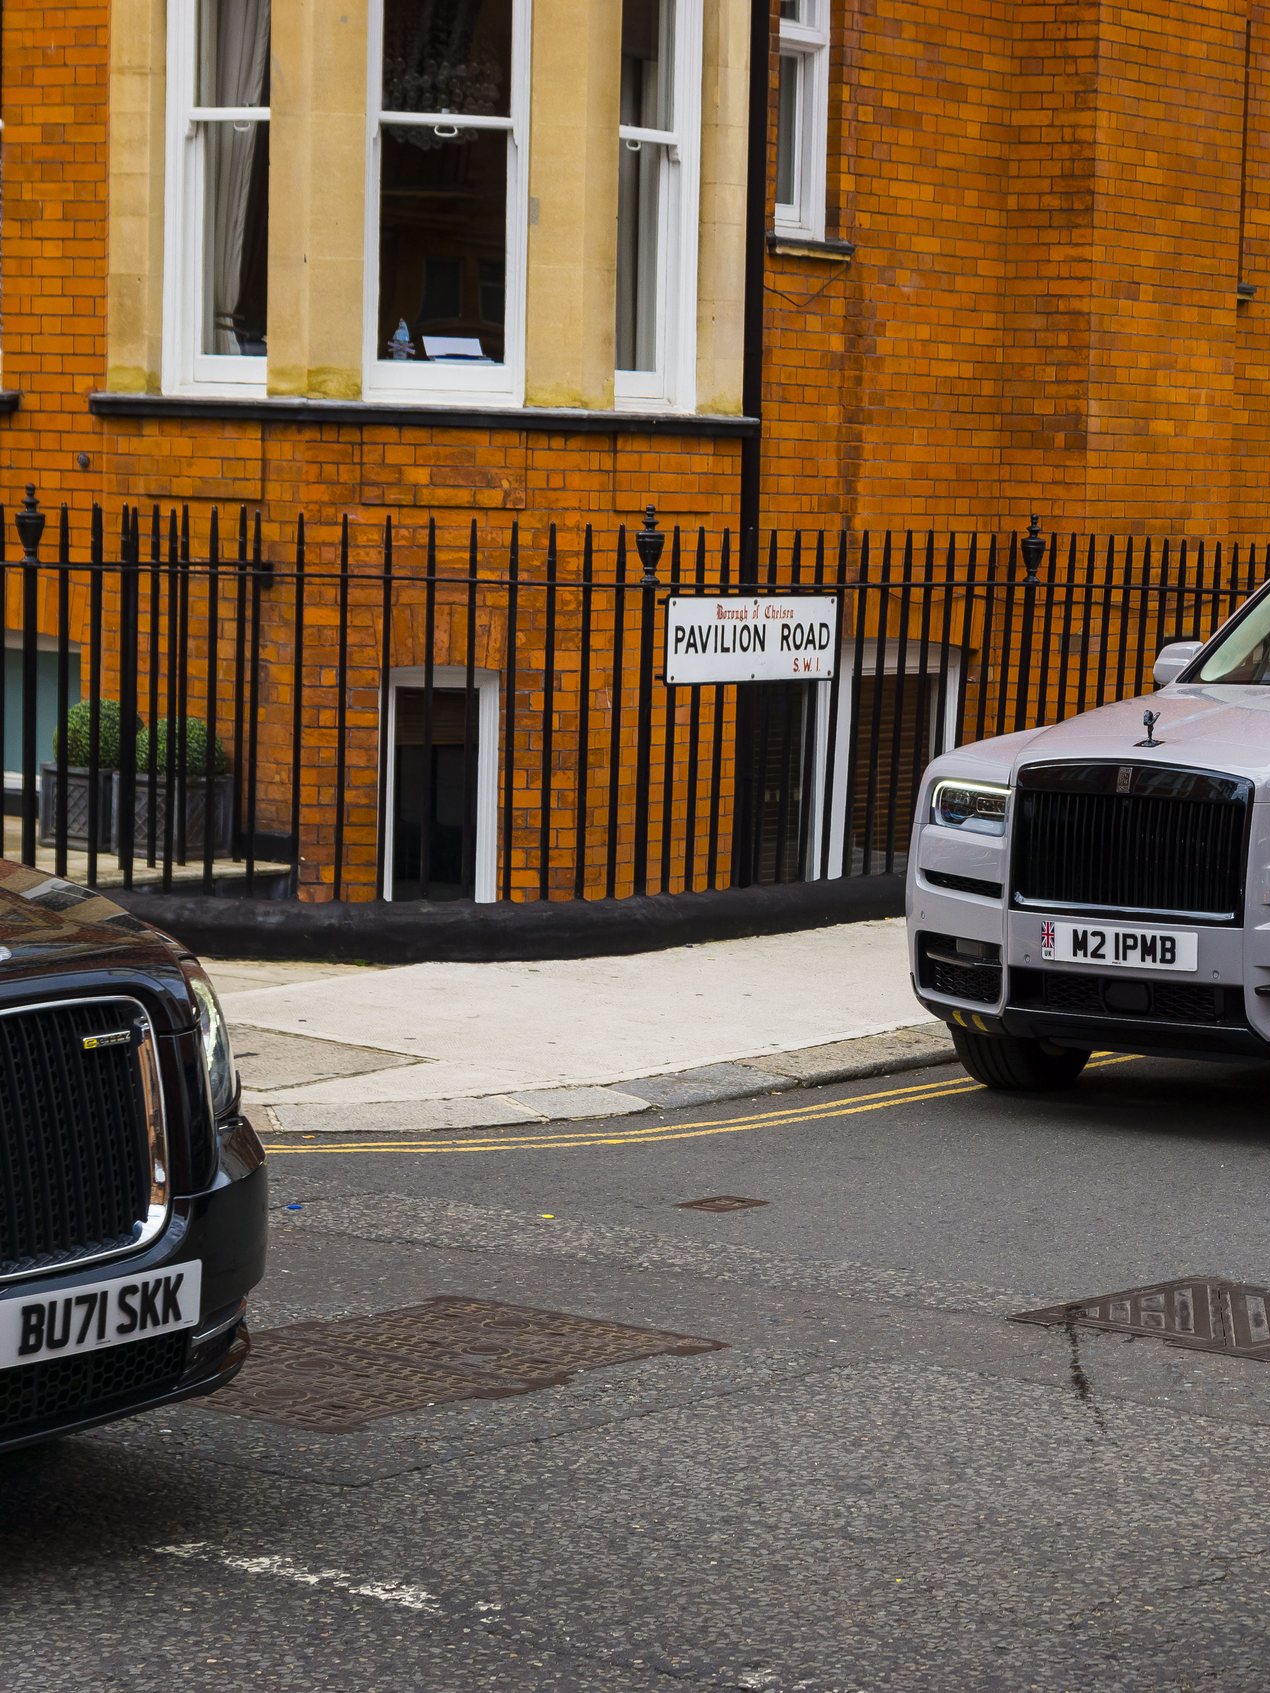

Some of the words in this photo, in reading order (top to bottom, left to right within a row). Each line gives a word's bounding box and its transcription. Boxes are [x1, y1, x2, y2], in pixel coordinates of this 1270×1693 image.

[716, 604, 748, 622] Borough
[752, 604, 760, 619] of
[764, 604, 794, 620] Chelsea
[674, 623, 767, 655] PAVILION
[780, 622, 831, 652] ROAD
[1072, 929, 1106, 960] M2
[18, 1290, 109, 1356] BU71
[116, 1272, 185, 1335] SKK
